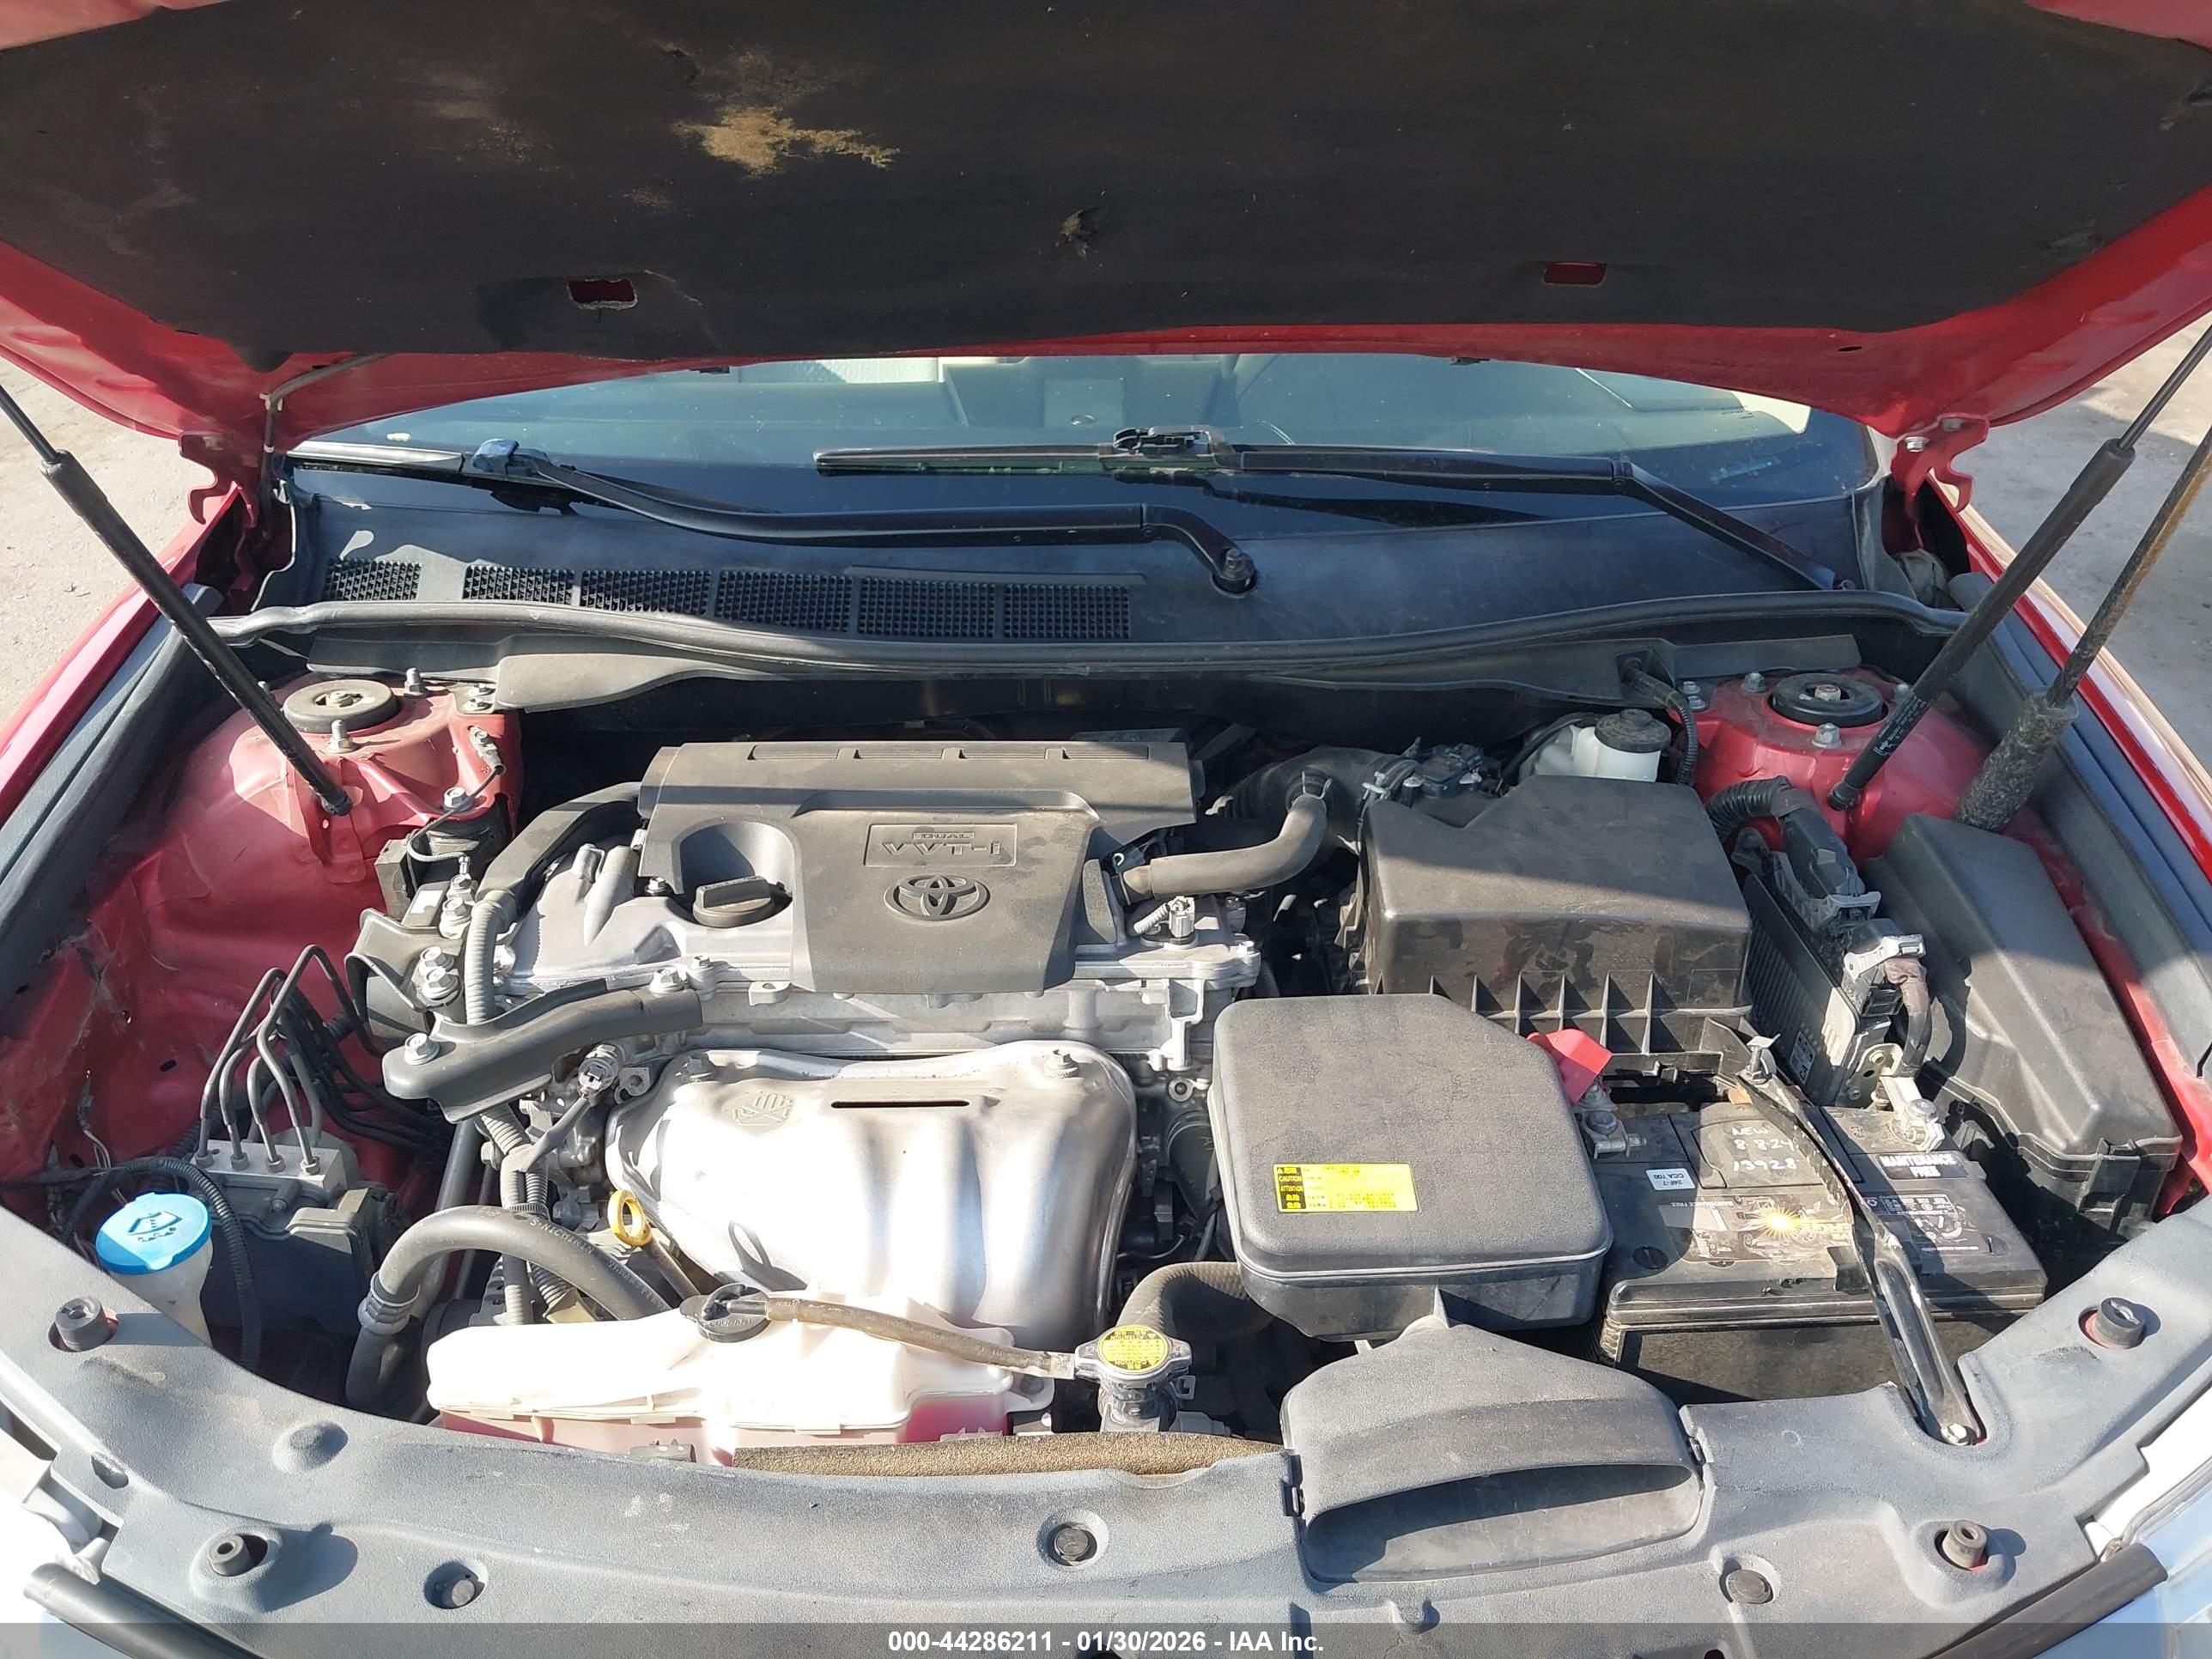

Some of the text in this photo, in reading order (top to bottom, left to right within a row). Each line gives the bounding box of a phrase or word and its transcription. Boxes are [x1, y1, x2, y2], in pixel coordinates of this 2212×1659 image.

[1731, 1127, 1769, 1136] NEW
[1733, 1157, 1797, 1172] 13928
[1879, 1153, 1957, 1167] MAINTENANCE
